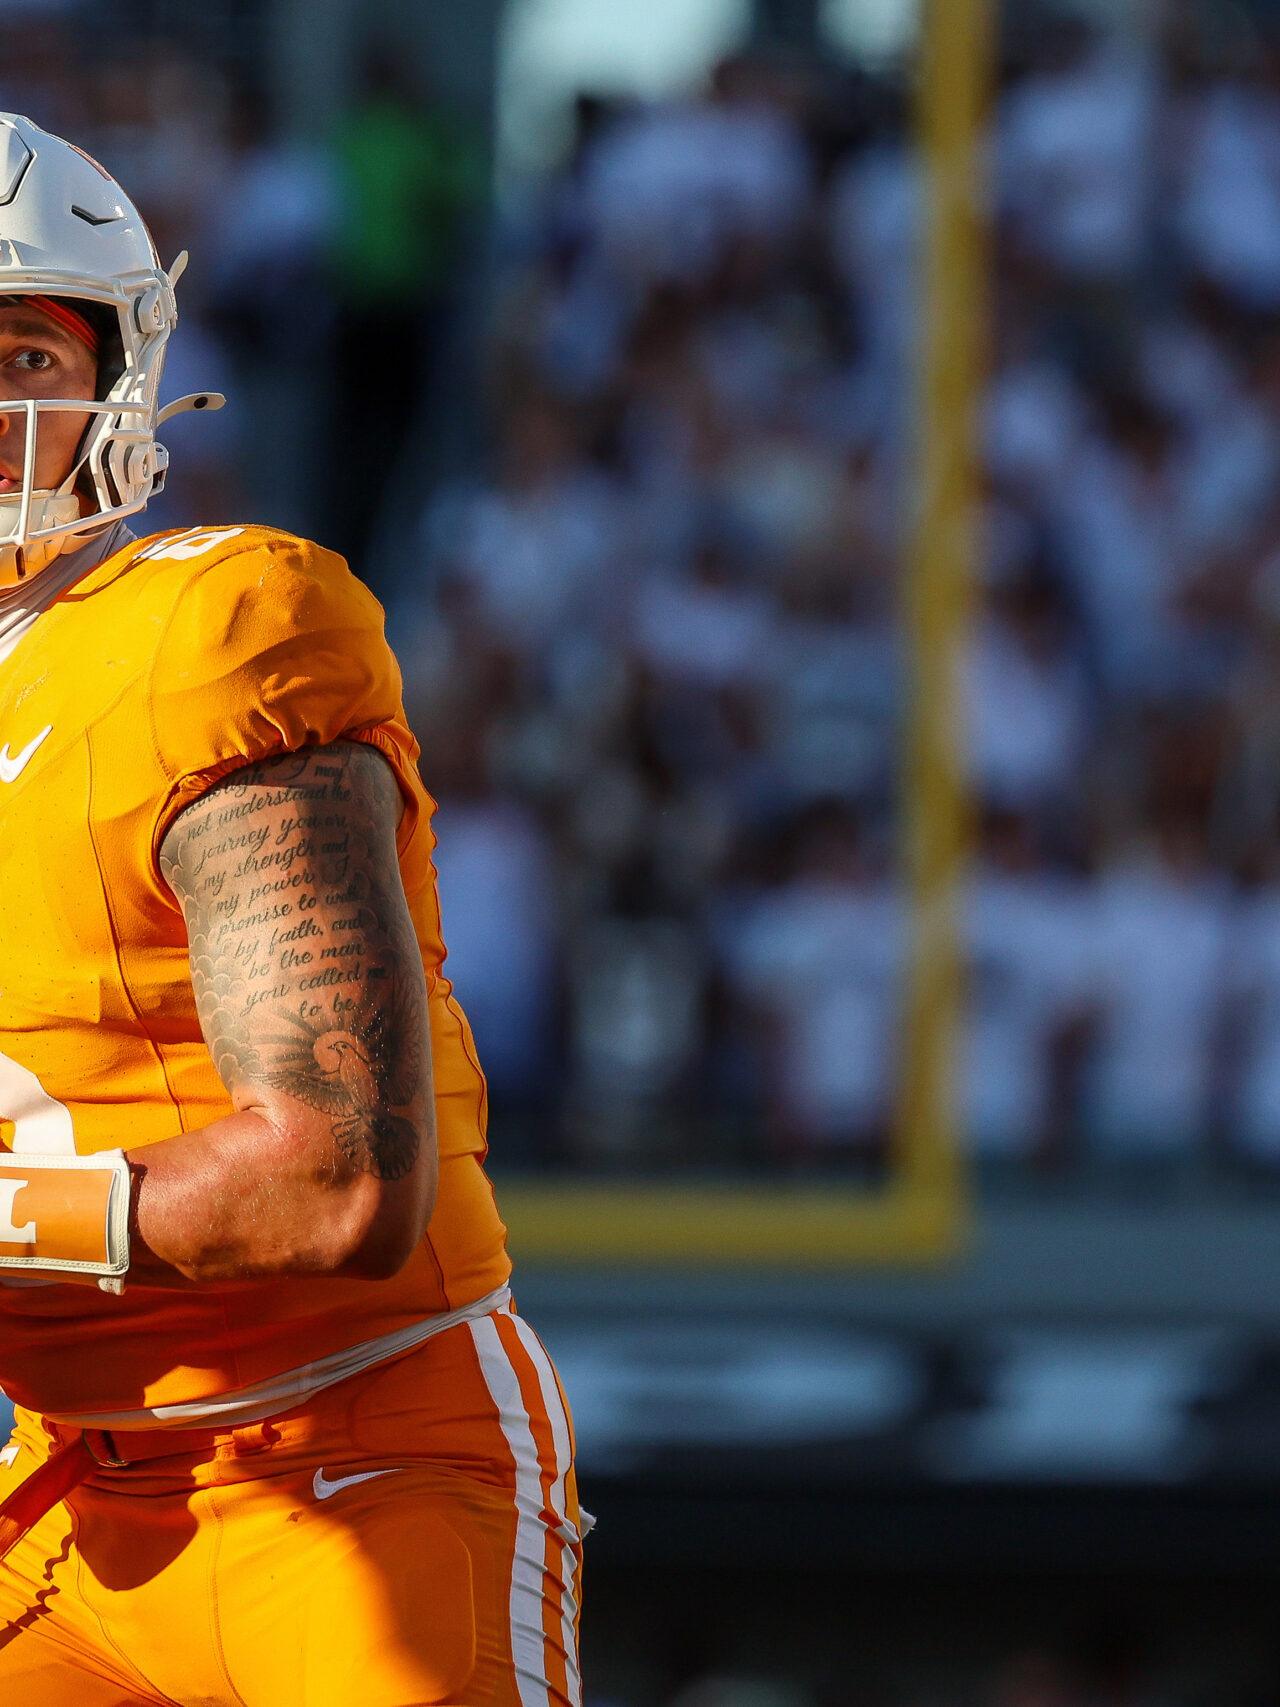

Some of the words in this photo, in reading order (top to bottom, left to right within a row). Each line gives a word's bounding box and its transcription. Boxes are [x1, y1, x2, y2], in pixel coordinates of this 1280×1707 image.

[187, 813, 215, 841] not
[218, 784, 328, 827] understand
[193, 825, 271, 876] journey
[276, 813, 321, 845] you
[203, 870, 227, 896] my
[233, 838, 316, 880] strength
[322, 833, 350, 854] and
[215, 894, 239, 918] my
[247, 871, 317, 909] power
[216, 902, 293, 946] promise
[297, 893, 318, 909] to
[233, 939, 260, 966] by
[268, 917, 324, 957] faith,
[331, 909, 365, 932] and
[248, 961, 271, 981] be
[280, 947, 314, 972] the
[320, 943, 367, 961] man
[239, 984, 292, 1018] you
[298, 962, 362, 993] called
[298, 998, 323, 1019] to
